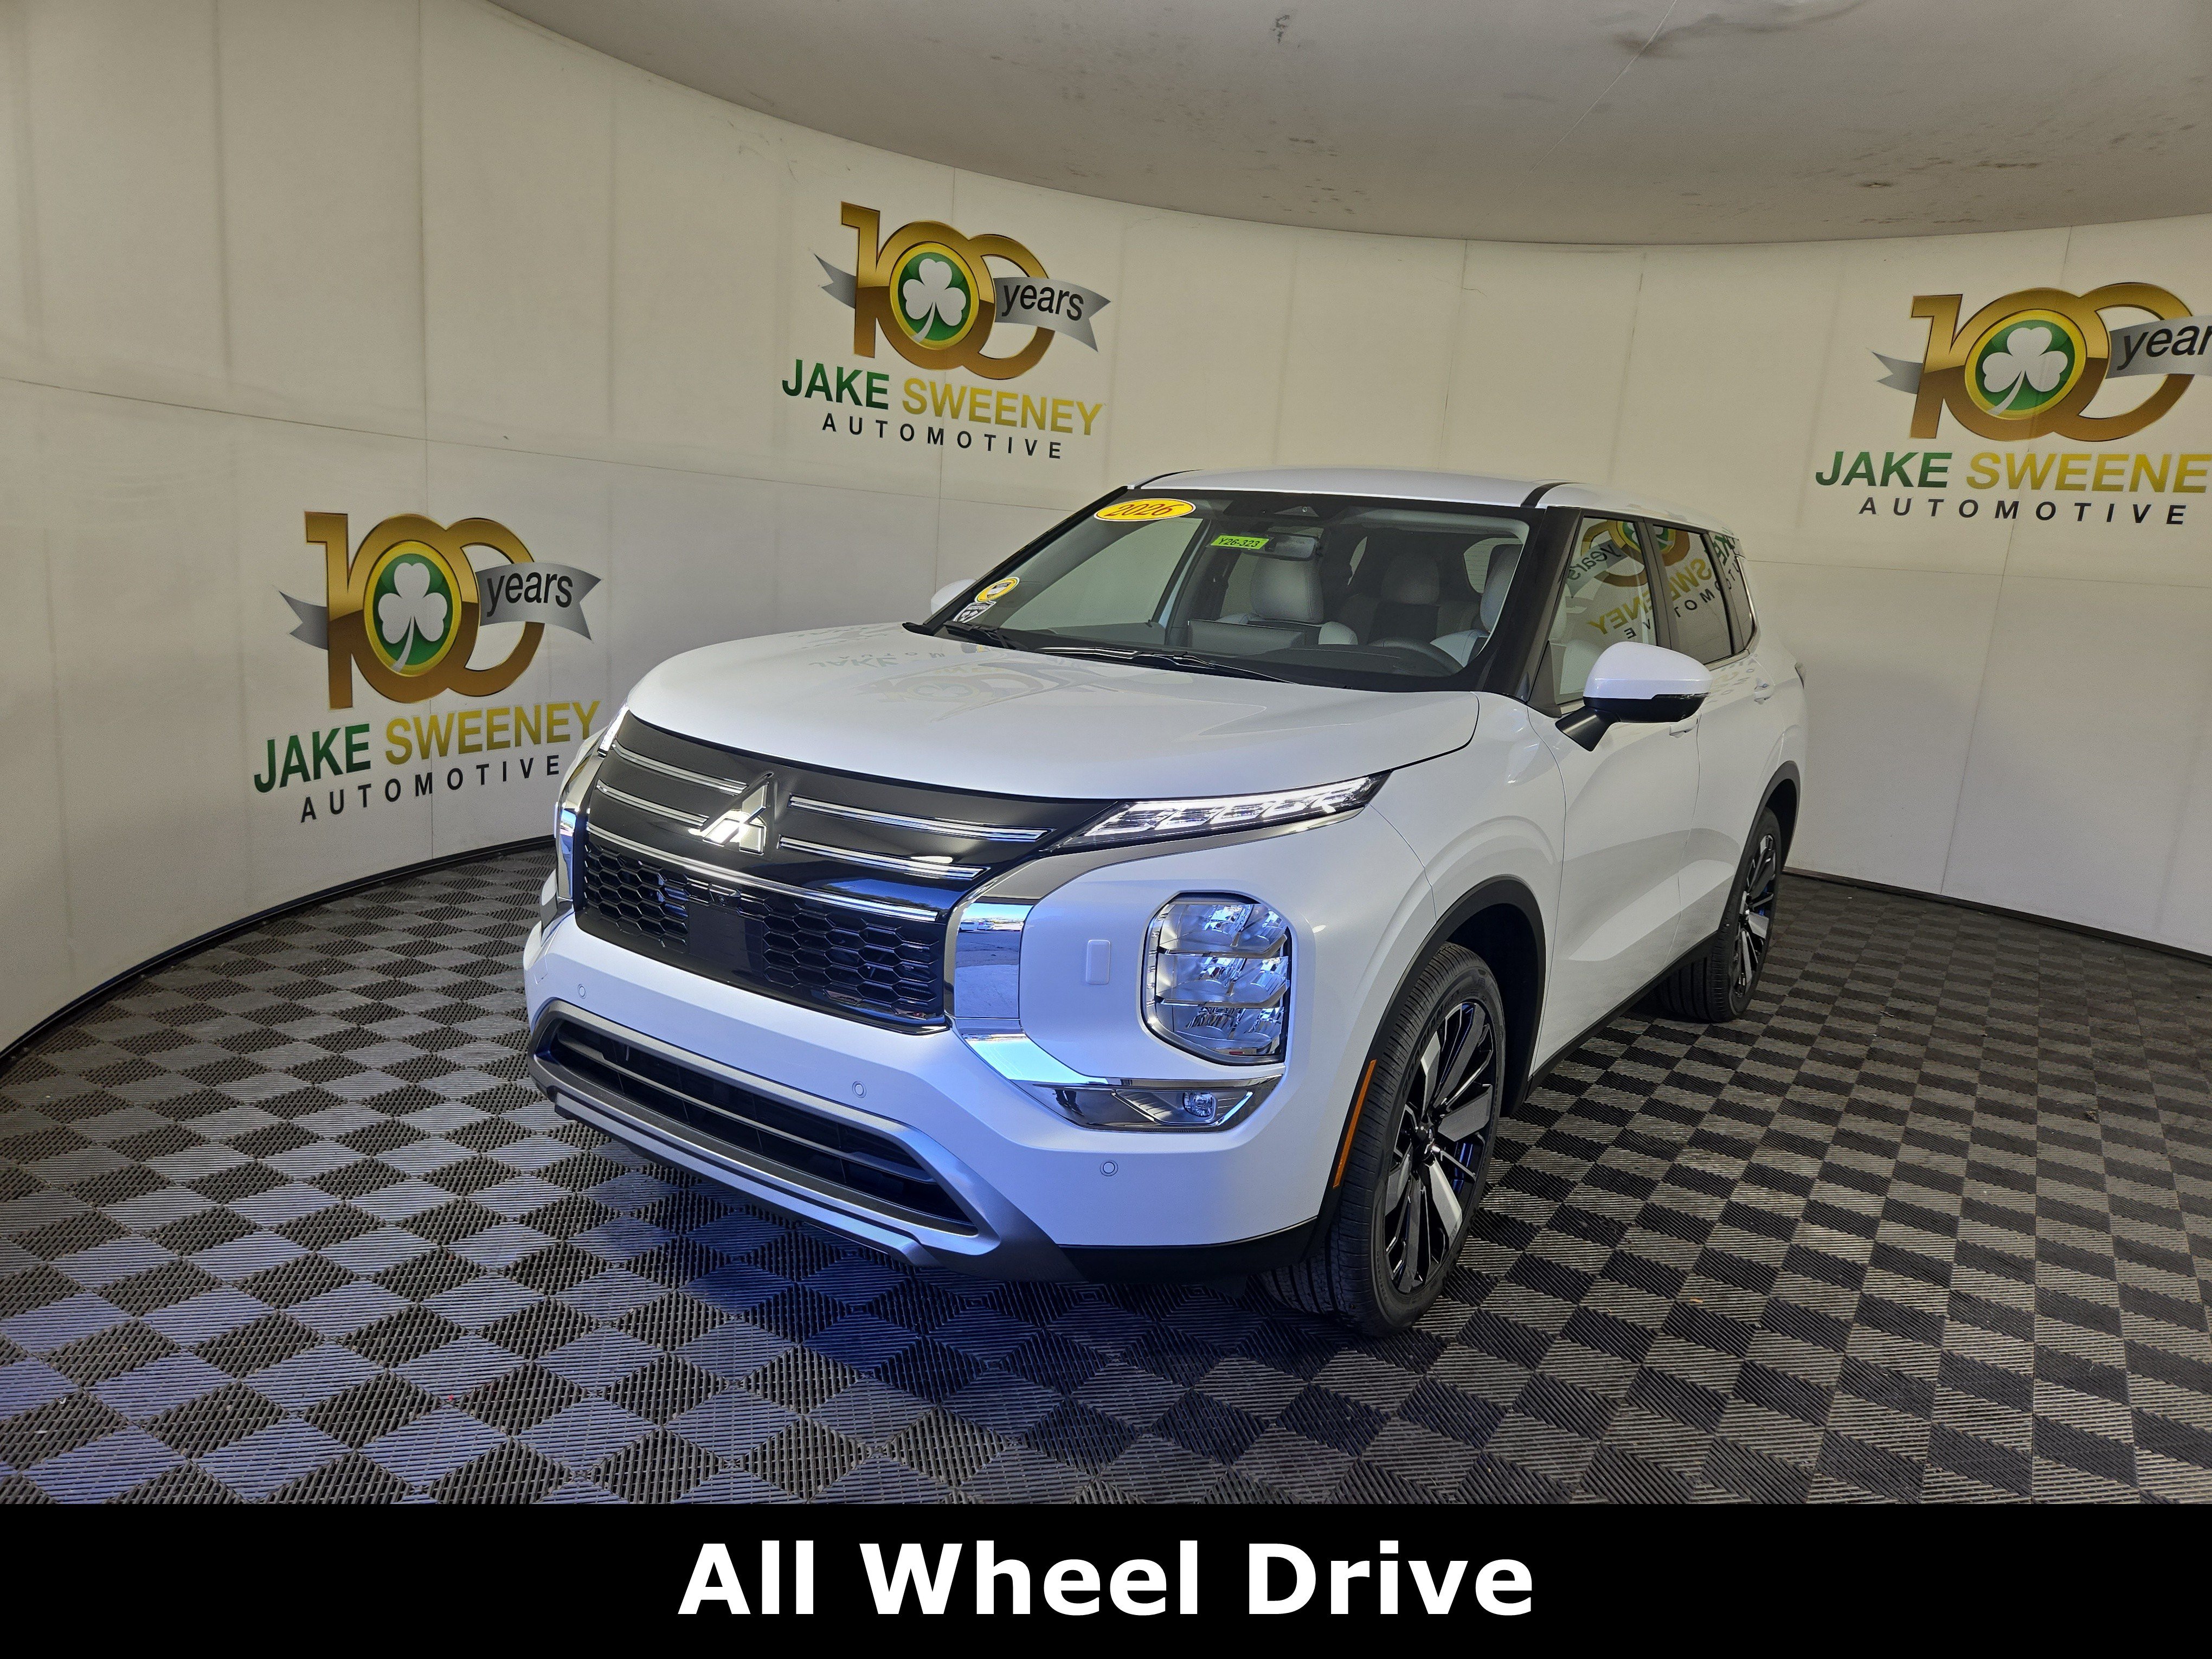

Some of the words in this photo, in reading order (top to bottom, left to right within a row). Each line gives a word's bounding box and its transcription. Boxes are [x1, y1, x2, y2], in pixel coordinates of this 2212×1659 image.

[840, 201, 1057, 380] 100
[1001, 282, 1085, 321] years
[1909, 281, 2194, 442] 100
[2117, 325, 2212, 371] year
[782, 358, 890, 410] JAKE
[902, 377, 1103, 436] SWEENEY
[822, 413, 1062, 459] AUTOMOTIVE
[1815, 451, 1953, 488] JAKE
[1966, 452, 2212, 493] SWEENE
[1103, 503, 1185, 517] 2026
[1218, 538, 1261, 548] Y26-323
[1859, 497, 2187, 525] AUTOMOTIVE
[304, 510, 545, 710] 100
[486, 571, 573, 617] years
[253, 723, 371, 793] JAKE
[385, 700, 602, 766] SWEENEY
[300, 754, 560, 823] AUTOMOTIVE
